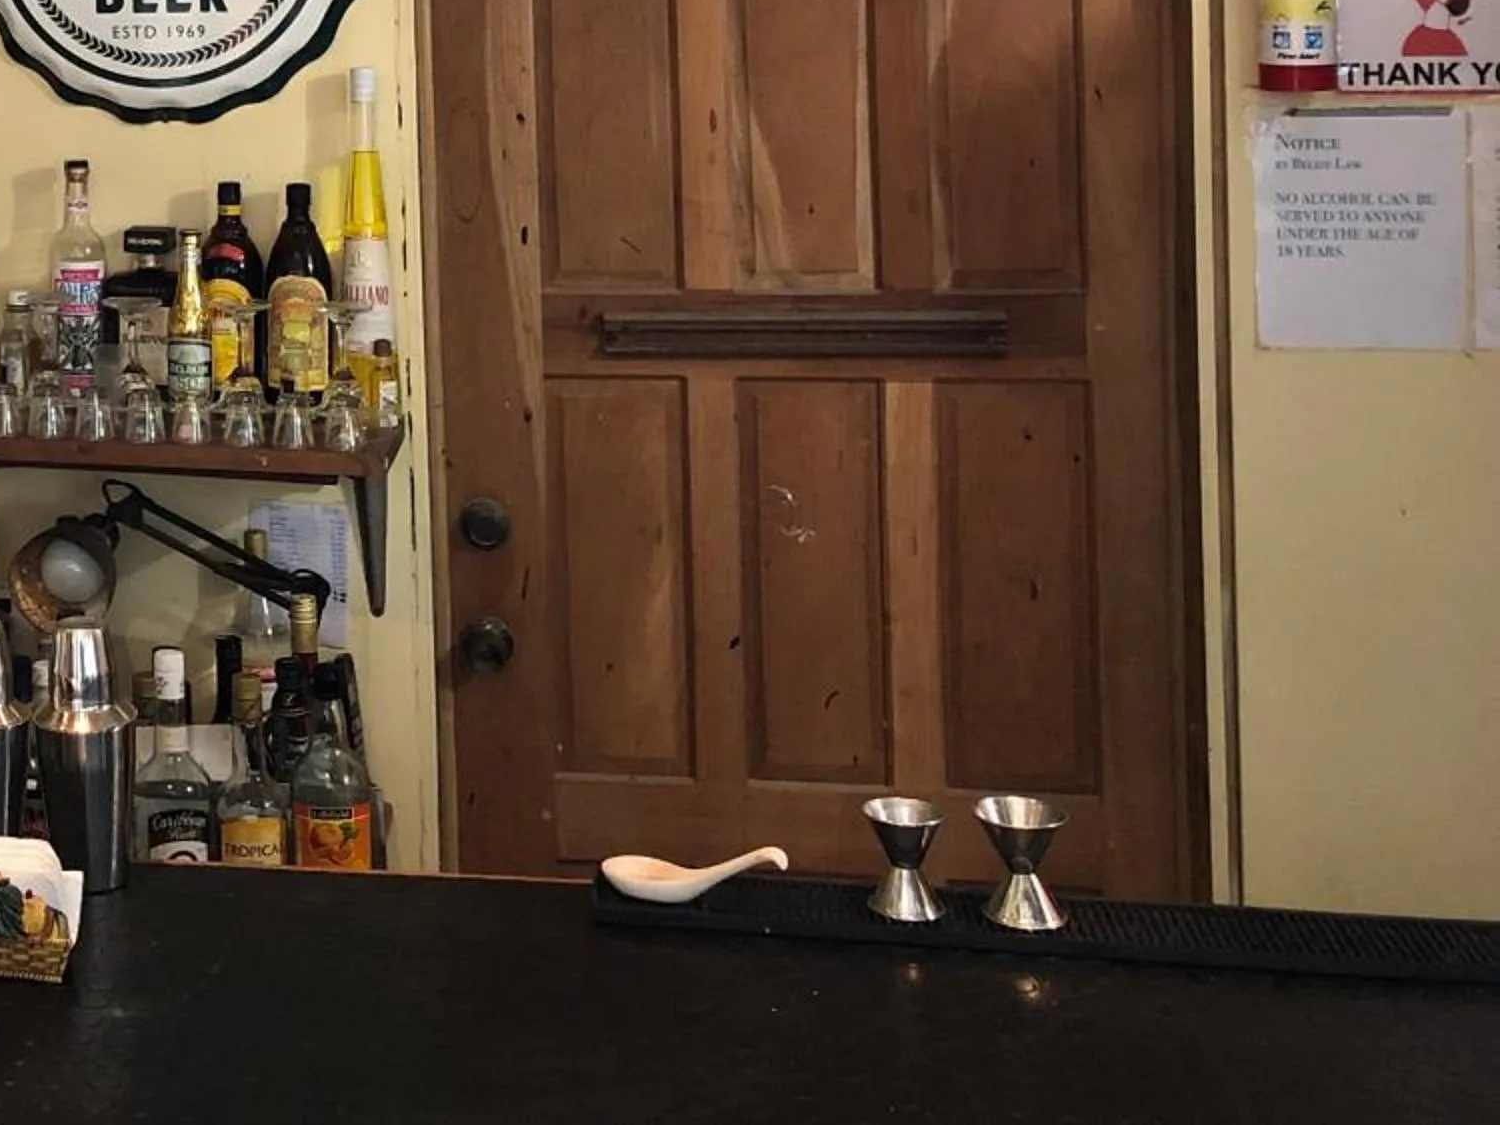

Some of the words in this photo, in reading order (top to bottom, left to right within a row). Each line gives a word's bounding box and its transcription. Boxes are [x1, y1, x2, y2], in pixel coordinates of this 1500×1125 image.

[112, 25, 157, 39] ESTD
[167, 24, 206, 38] 1969
[1340, 62, 1460, 85] THANK
[1471, 62, 1500, 85] Y
